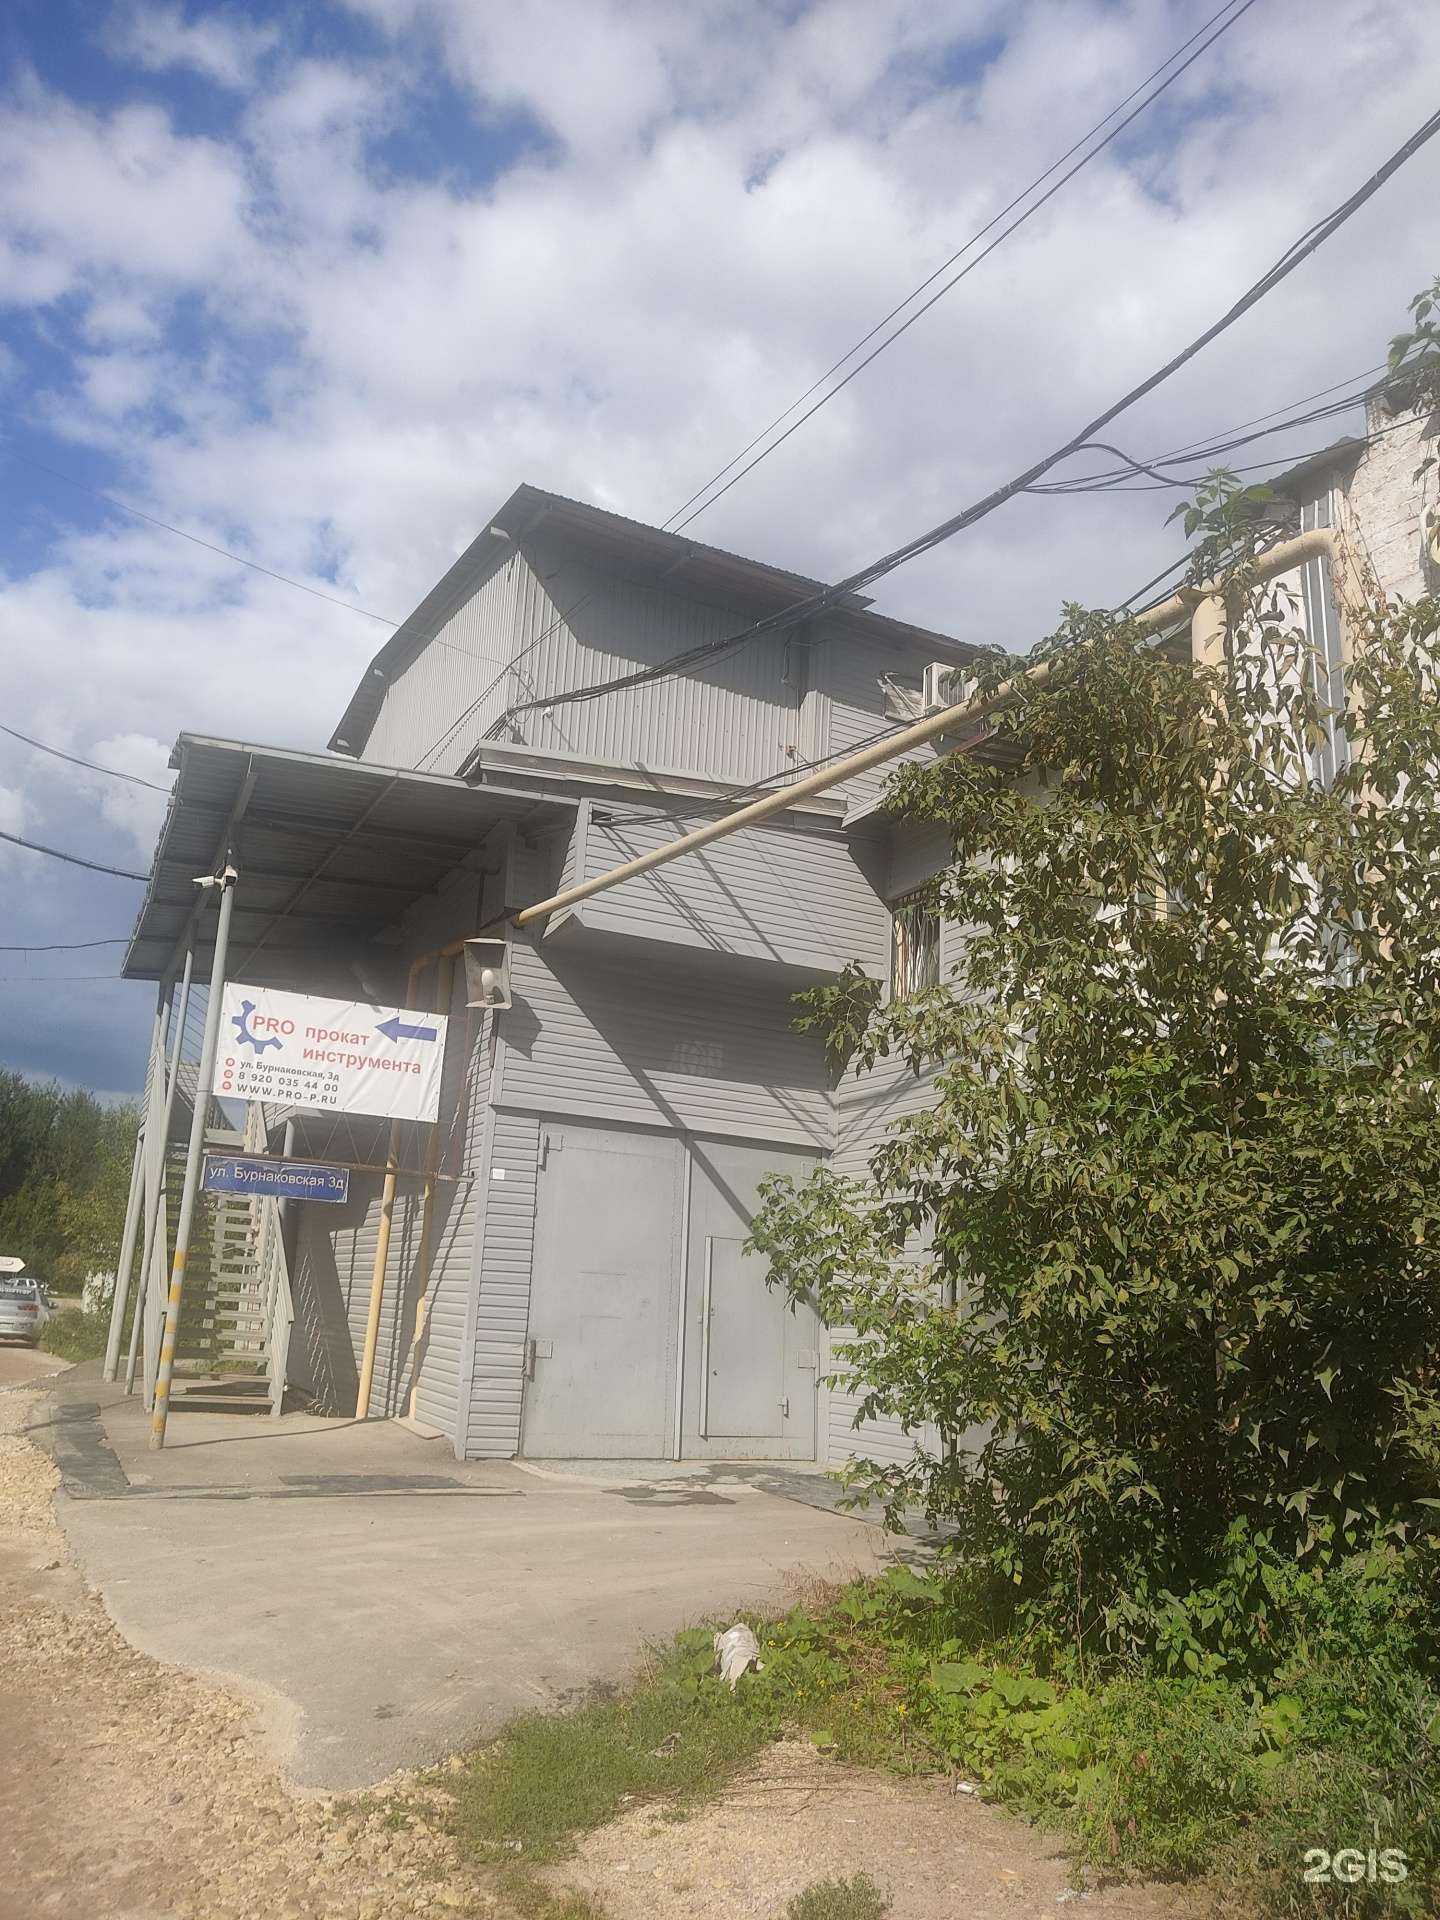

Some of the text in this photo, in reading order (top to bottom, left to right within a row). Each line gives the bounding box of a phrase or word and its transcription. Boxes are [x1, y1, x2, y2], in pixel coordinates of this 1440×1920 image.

[252, 1015, 295, 1035] PRO
[305, 1026, 370, 1046] прокат
[240, 1061, 340, 1082] ул. Бурнаковская, 3д
[303, 1048, 422, 1074] инструмента
[238, 1071, 339, 1093] 8 920 035 44 00
[236, 1083, 337, 1105] WWW.PRO-P.RU
[209, 1165, 344, 1191] ул. Бурнаковская 3д
